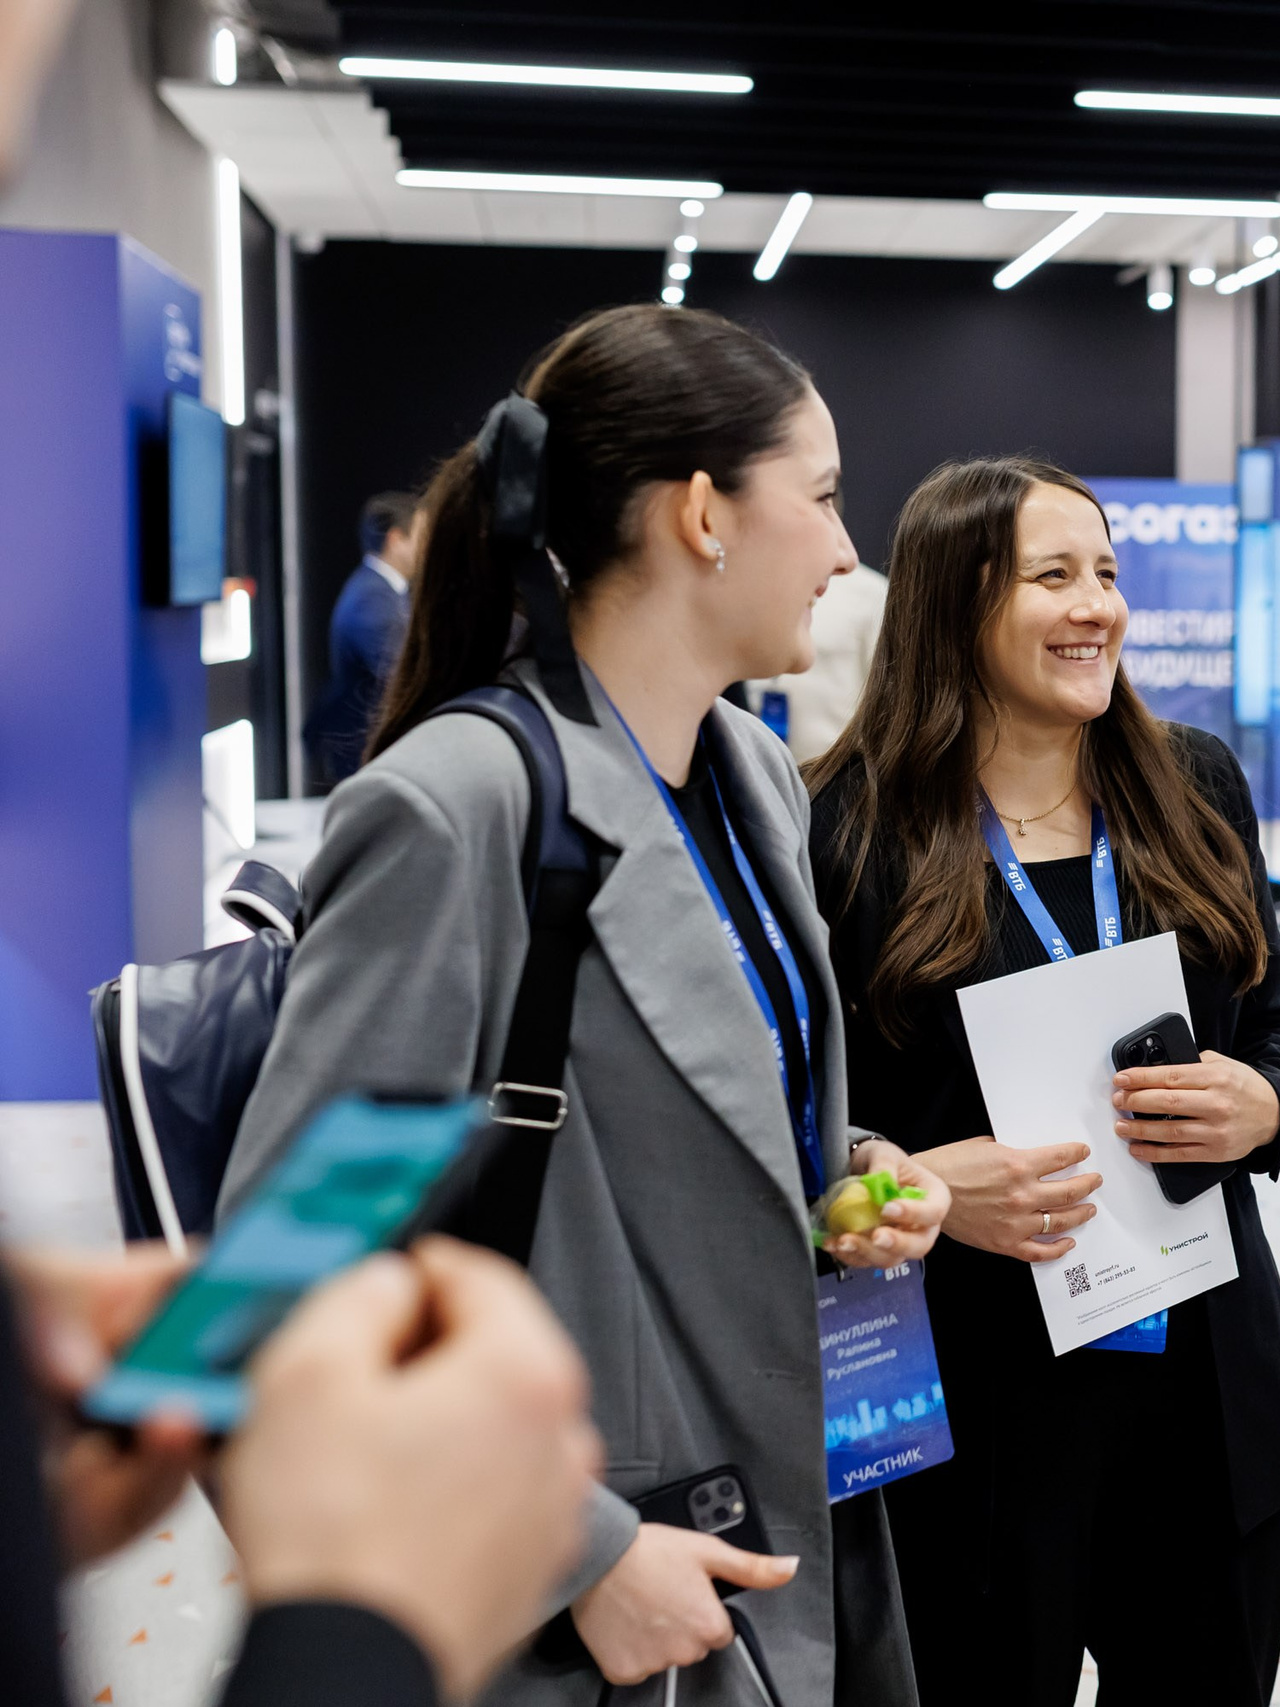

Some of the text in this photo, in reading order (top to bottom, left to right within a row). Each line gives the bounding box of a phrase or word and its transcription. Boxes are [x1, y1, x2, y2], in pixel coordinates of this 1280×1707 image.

[1096, 836, 1108, 860] ВТБ
[1007, 871, 1027, 892] ВТБ
[1104, 916, 1118, 938] ВТБ
[1052, 946, 1069, 960] ВТ
[1168, 1231, 1209, 1252] УНИСТРОЙ
[884, 1262, 911, 1281] ВТБ
[826, 1348, 898, 1380] Руслановна
[842, 1445, 924, 1489] УЧАСТНИК
